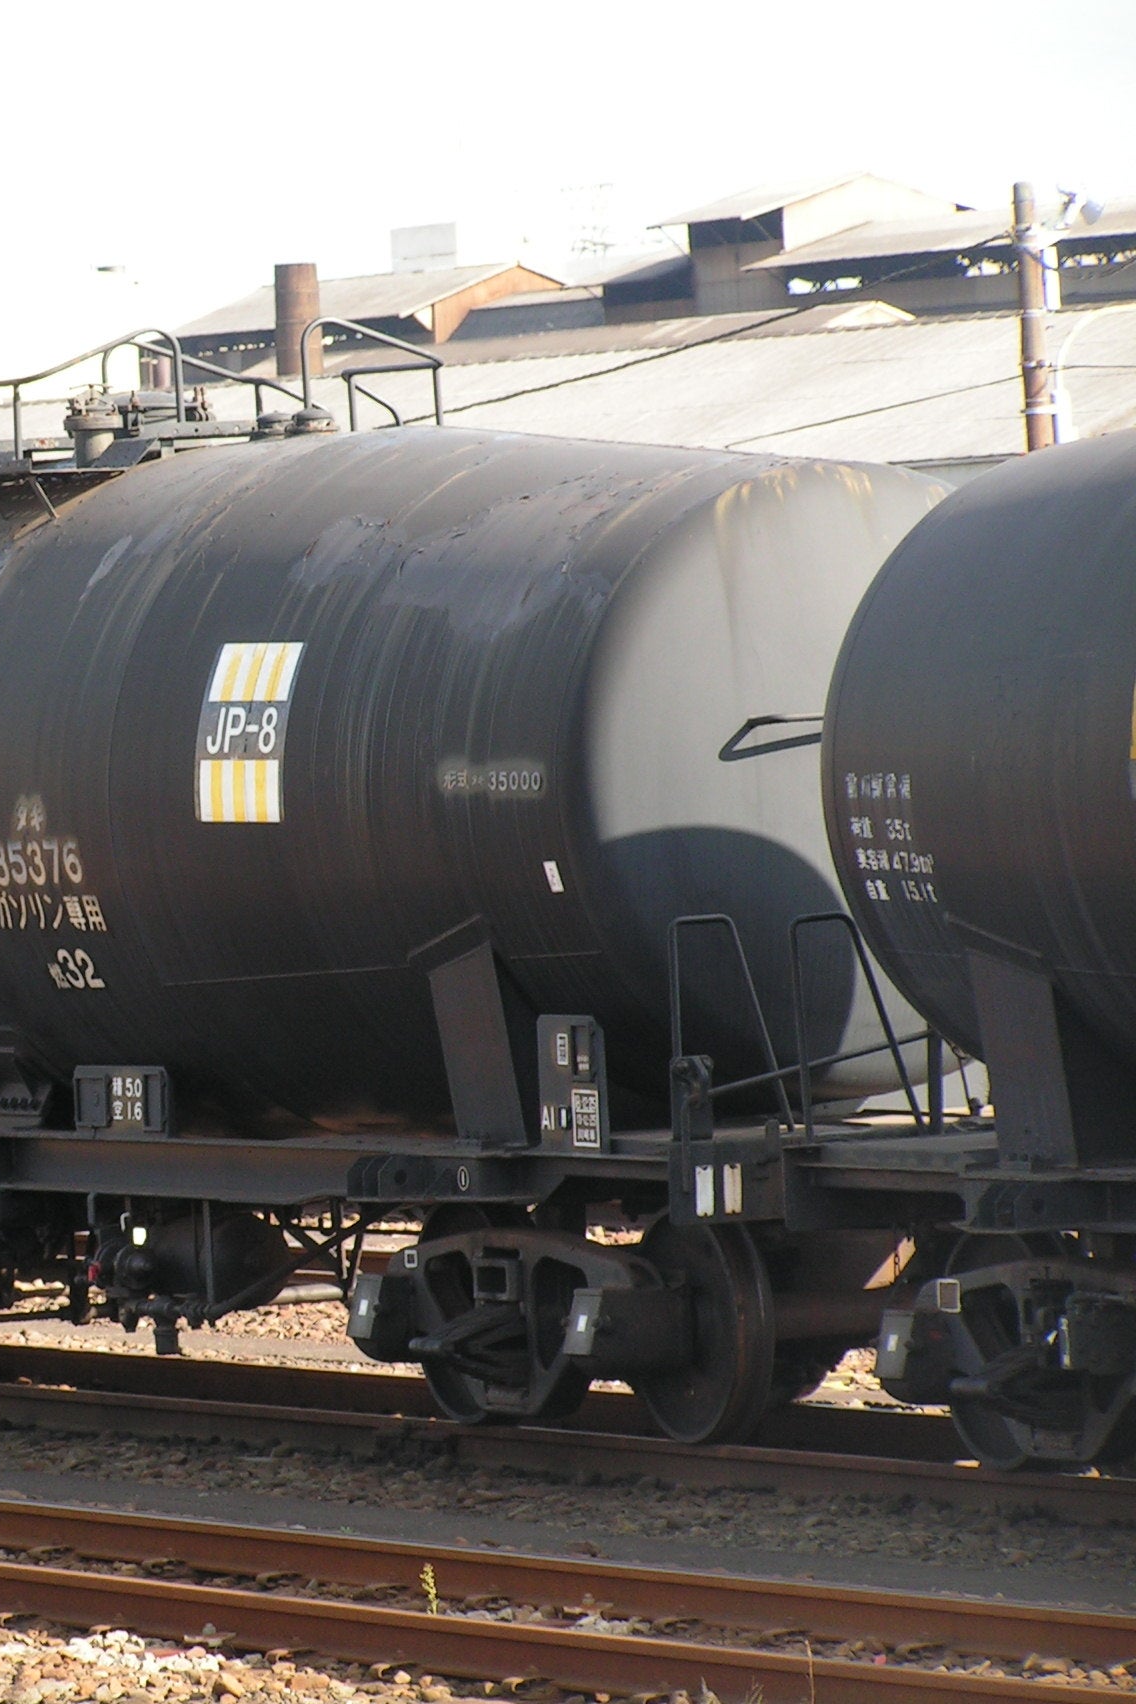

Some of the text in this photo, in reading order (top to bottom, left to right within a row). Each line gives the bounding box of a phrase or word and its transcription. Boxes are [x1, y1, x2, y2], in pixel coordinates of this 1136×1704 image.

[206, 706, 278, 755] JP-8
[488, 770, 541, 791] 35000
[112, 1100, 124, 1120] 空
